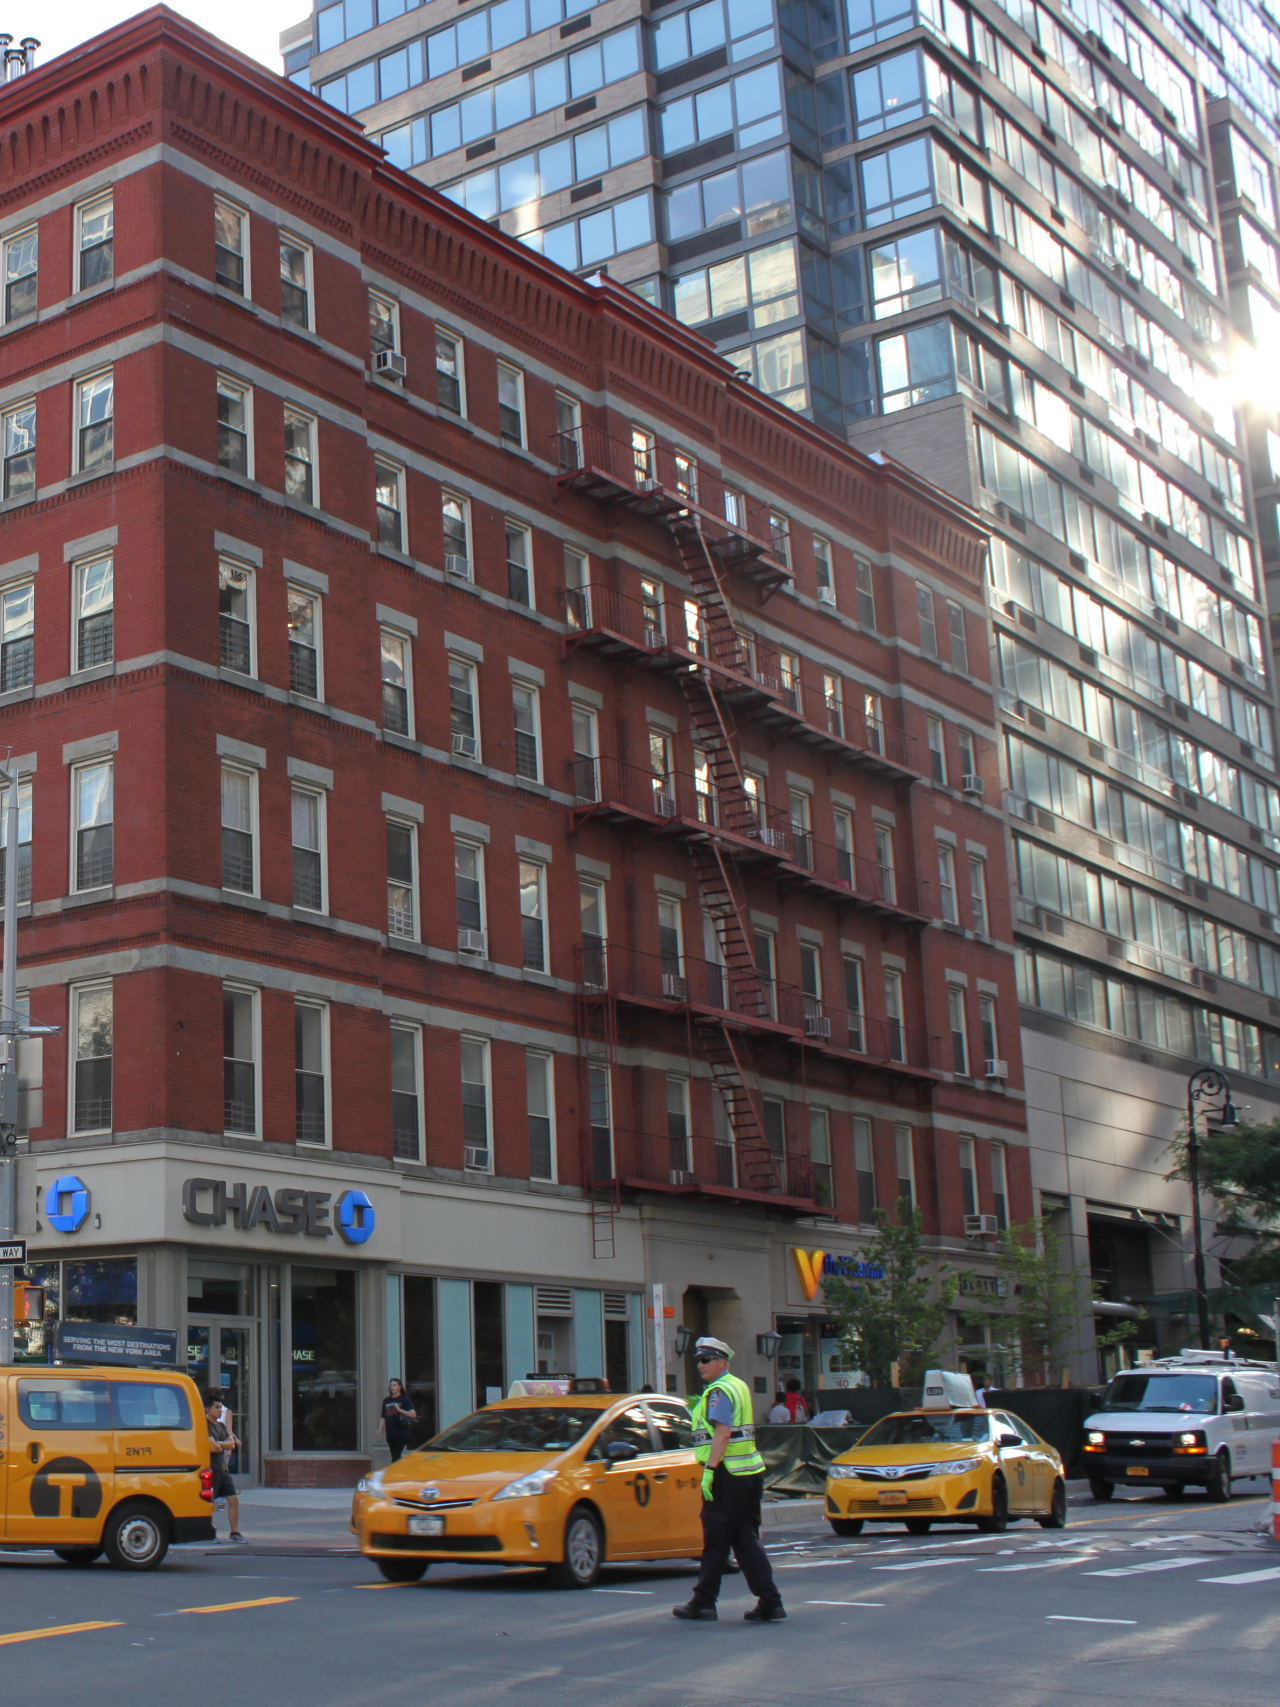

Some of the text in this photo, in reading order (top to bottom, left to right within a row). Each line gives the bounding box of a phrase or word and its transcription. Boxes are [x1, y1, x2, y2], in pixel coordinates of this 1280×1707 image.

[183, 1177, 333, 1237] CHASE
[2, 1248, 20, 1258] WAY
[63, 1336, 92, 1345] SERVING
[93, 1338, 106, 1346] THE
[107, 1339, 125, 1347] MOST
[126, 1341, 171, 1351] DESTINATIONS
[73, 1343, 93, 1352] FROM
[94, 1345, 107, 1353] THE
[108, 1346, 124, 1354] NEW
[144, 1349, 162, 1357] AREA
[293, 1350, 315, 1361] HASE
[126, 1447, 152, 1456] 2N19
